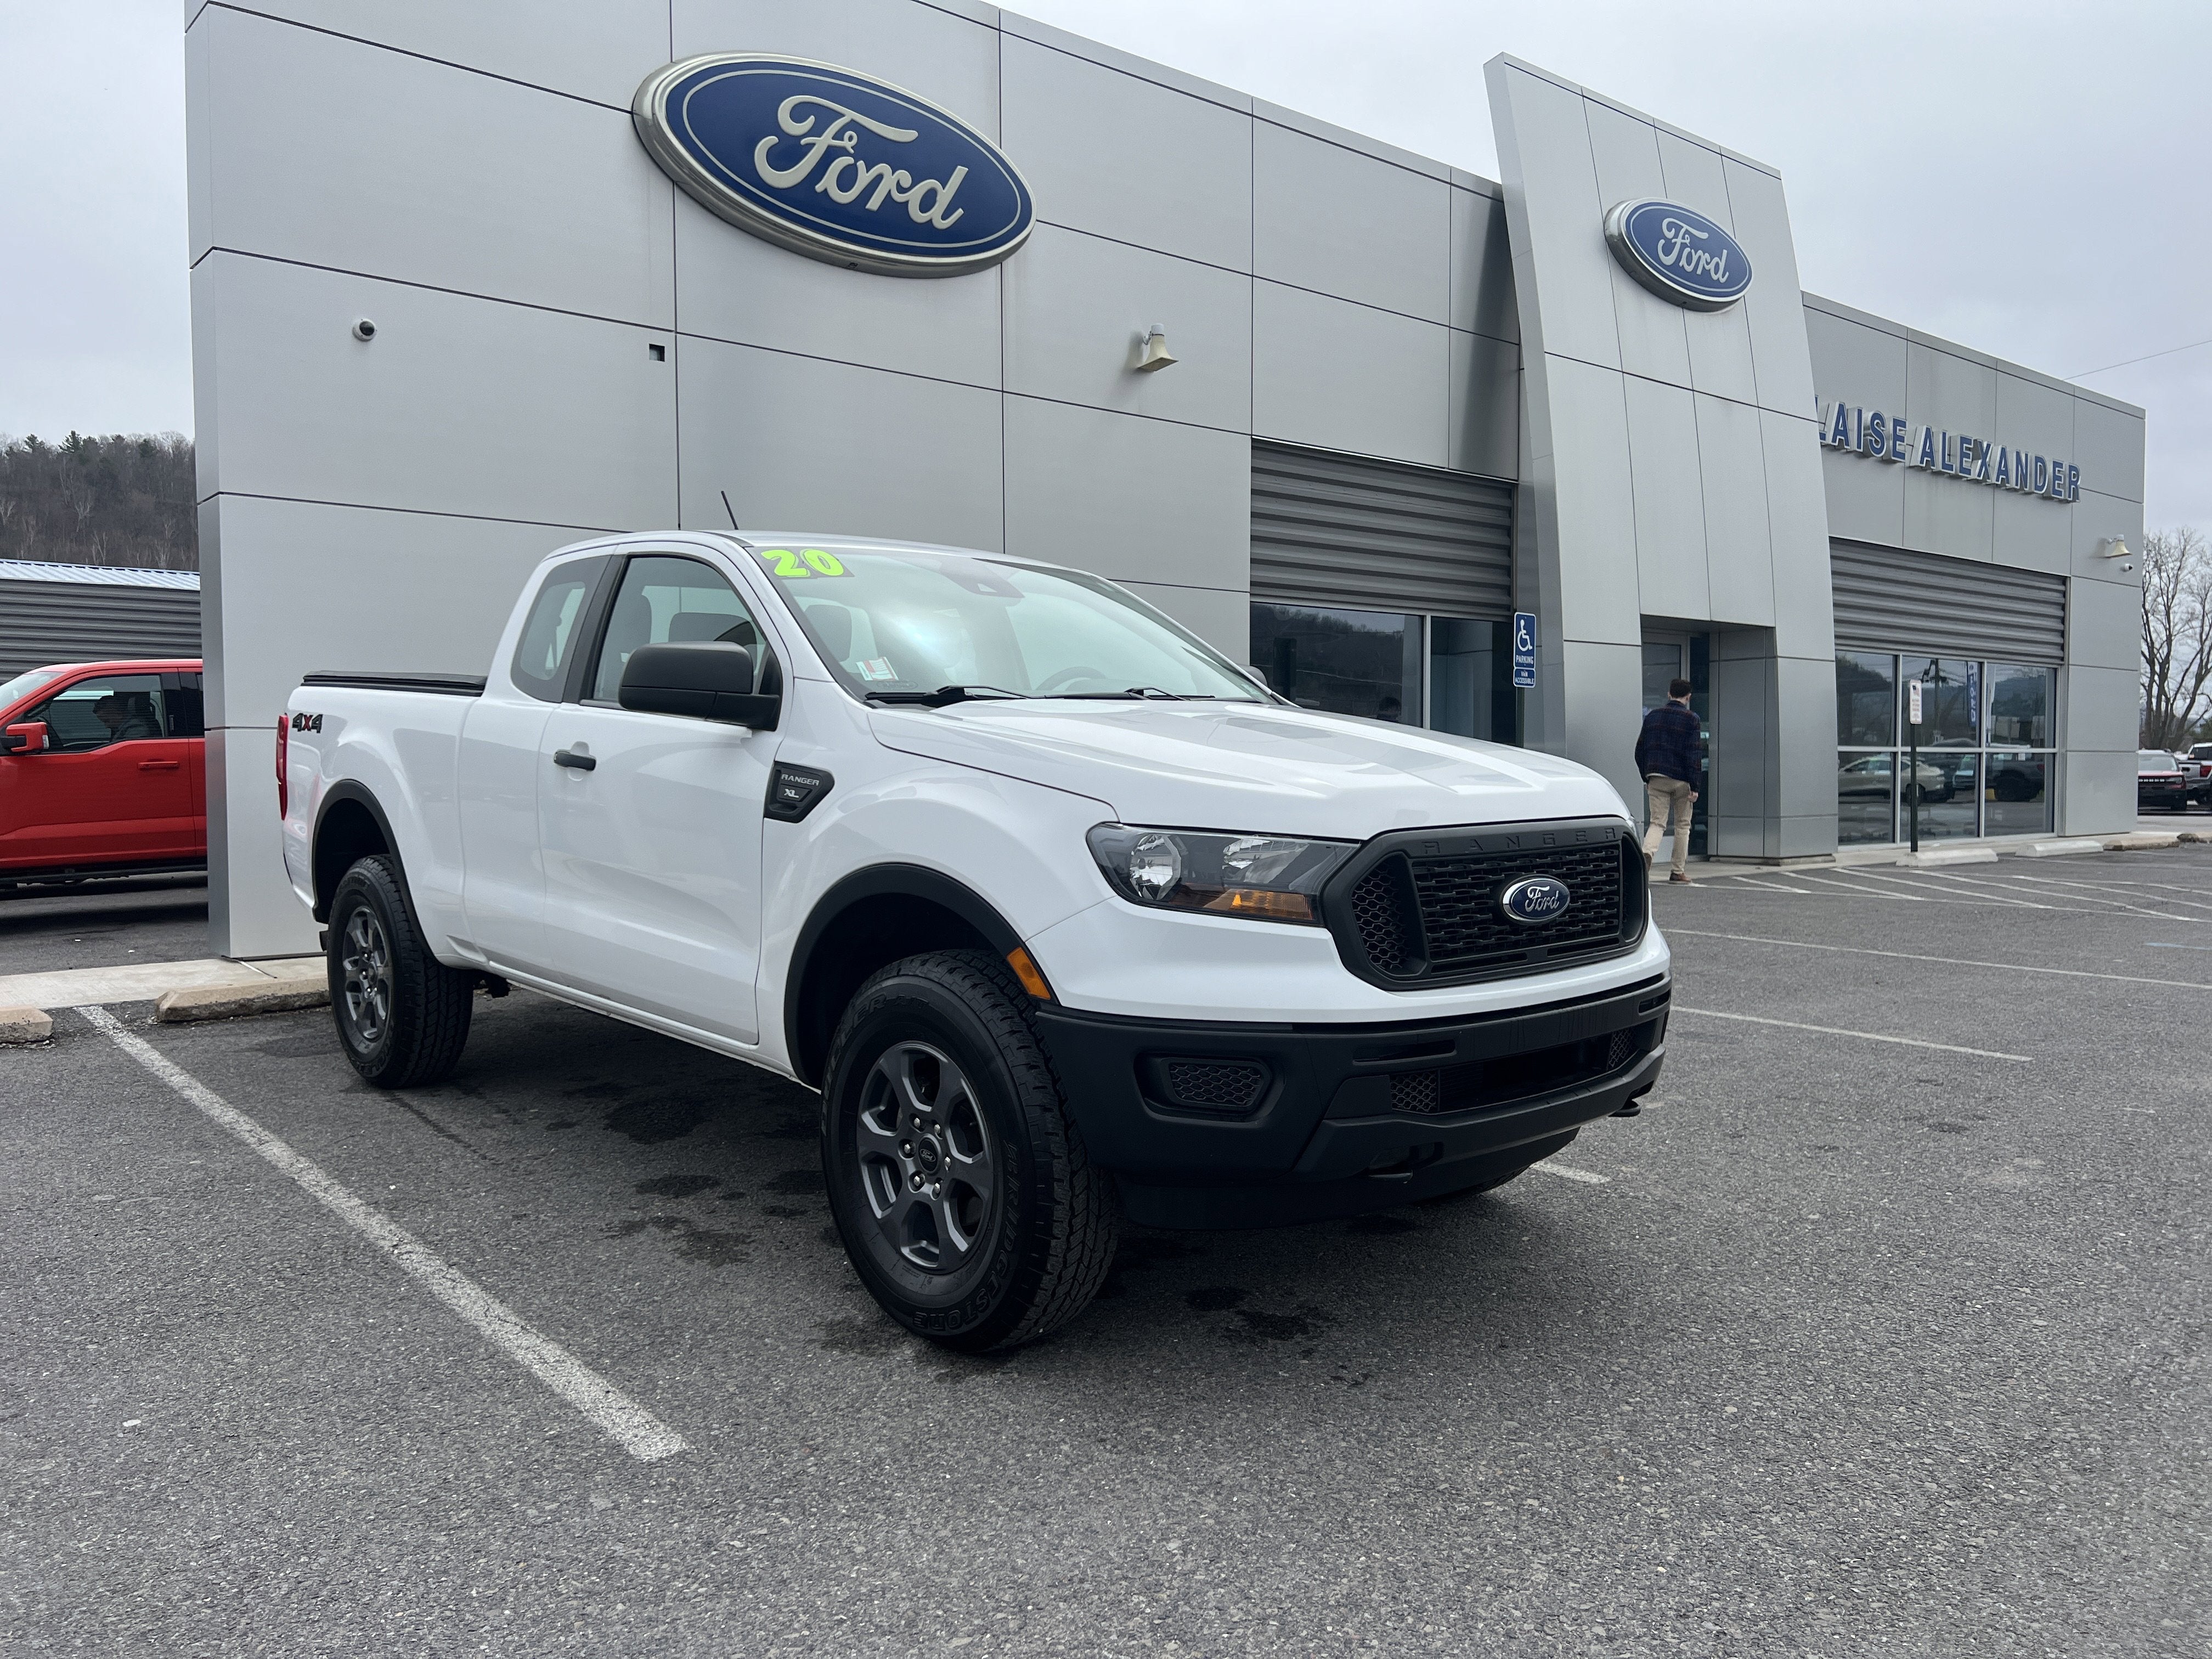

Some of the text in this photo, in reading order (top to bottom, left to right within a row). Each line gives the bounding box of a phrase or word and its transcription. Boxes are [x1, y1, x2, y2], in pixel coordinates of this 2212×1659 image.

[754, 94, 969, 229] Ford
[1657, 217, 1729, 283] Ford
[1919, 424, 2081, 503] ALEXANDER
[760, 549, 844, 578] 20
[1516, 654, 1534, 664] PARKING
[1515, 676, 1534, 685] ACCESSIBLE
[781, 774, 820, 786] RANGER
[784, 788, 799, 798] XL
[1421, 827, 1616, 854] RANGER
[1525, 885, 1560, 912] Ford
[922, 1150, 933, 1160] Ford
